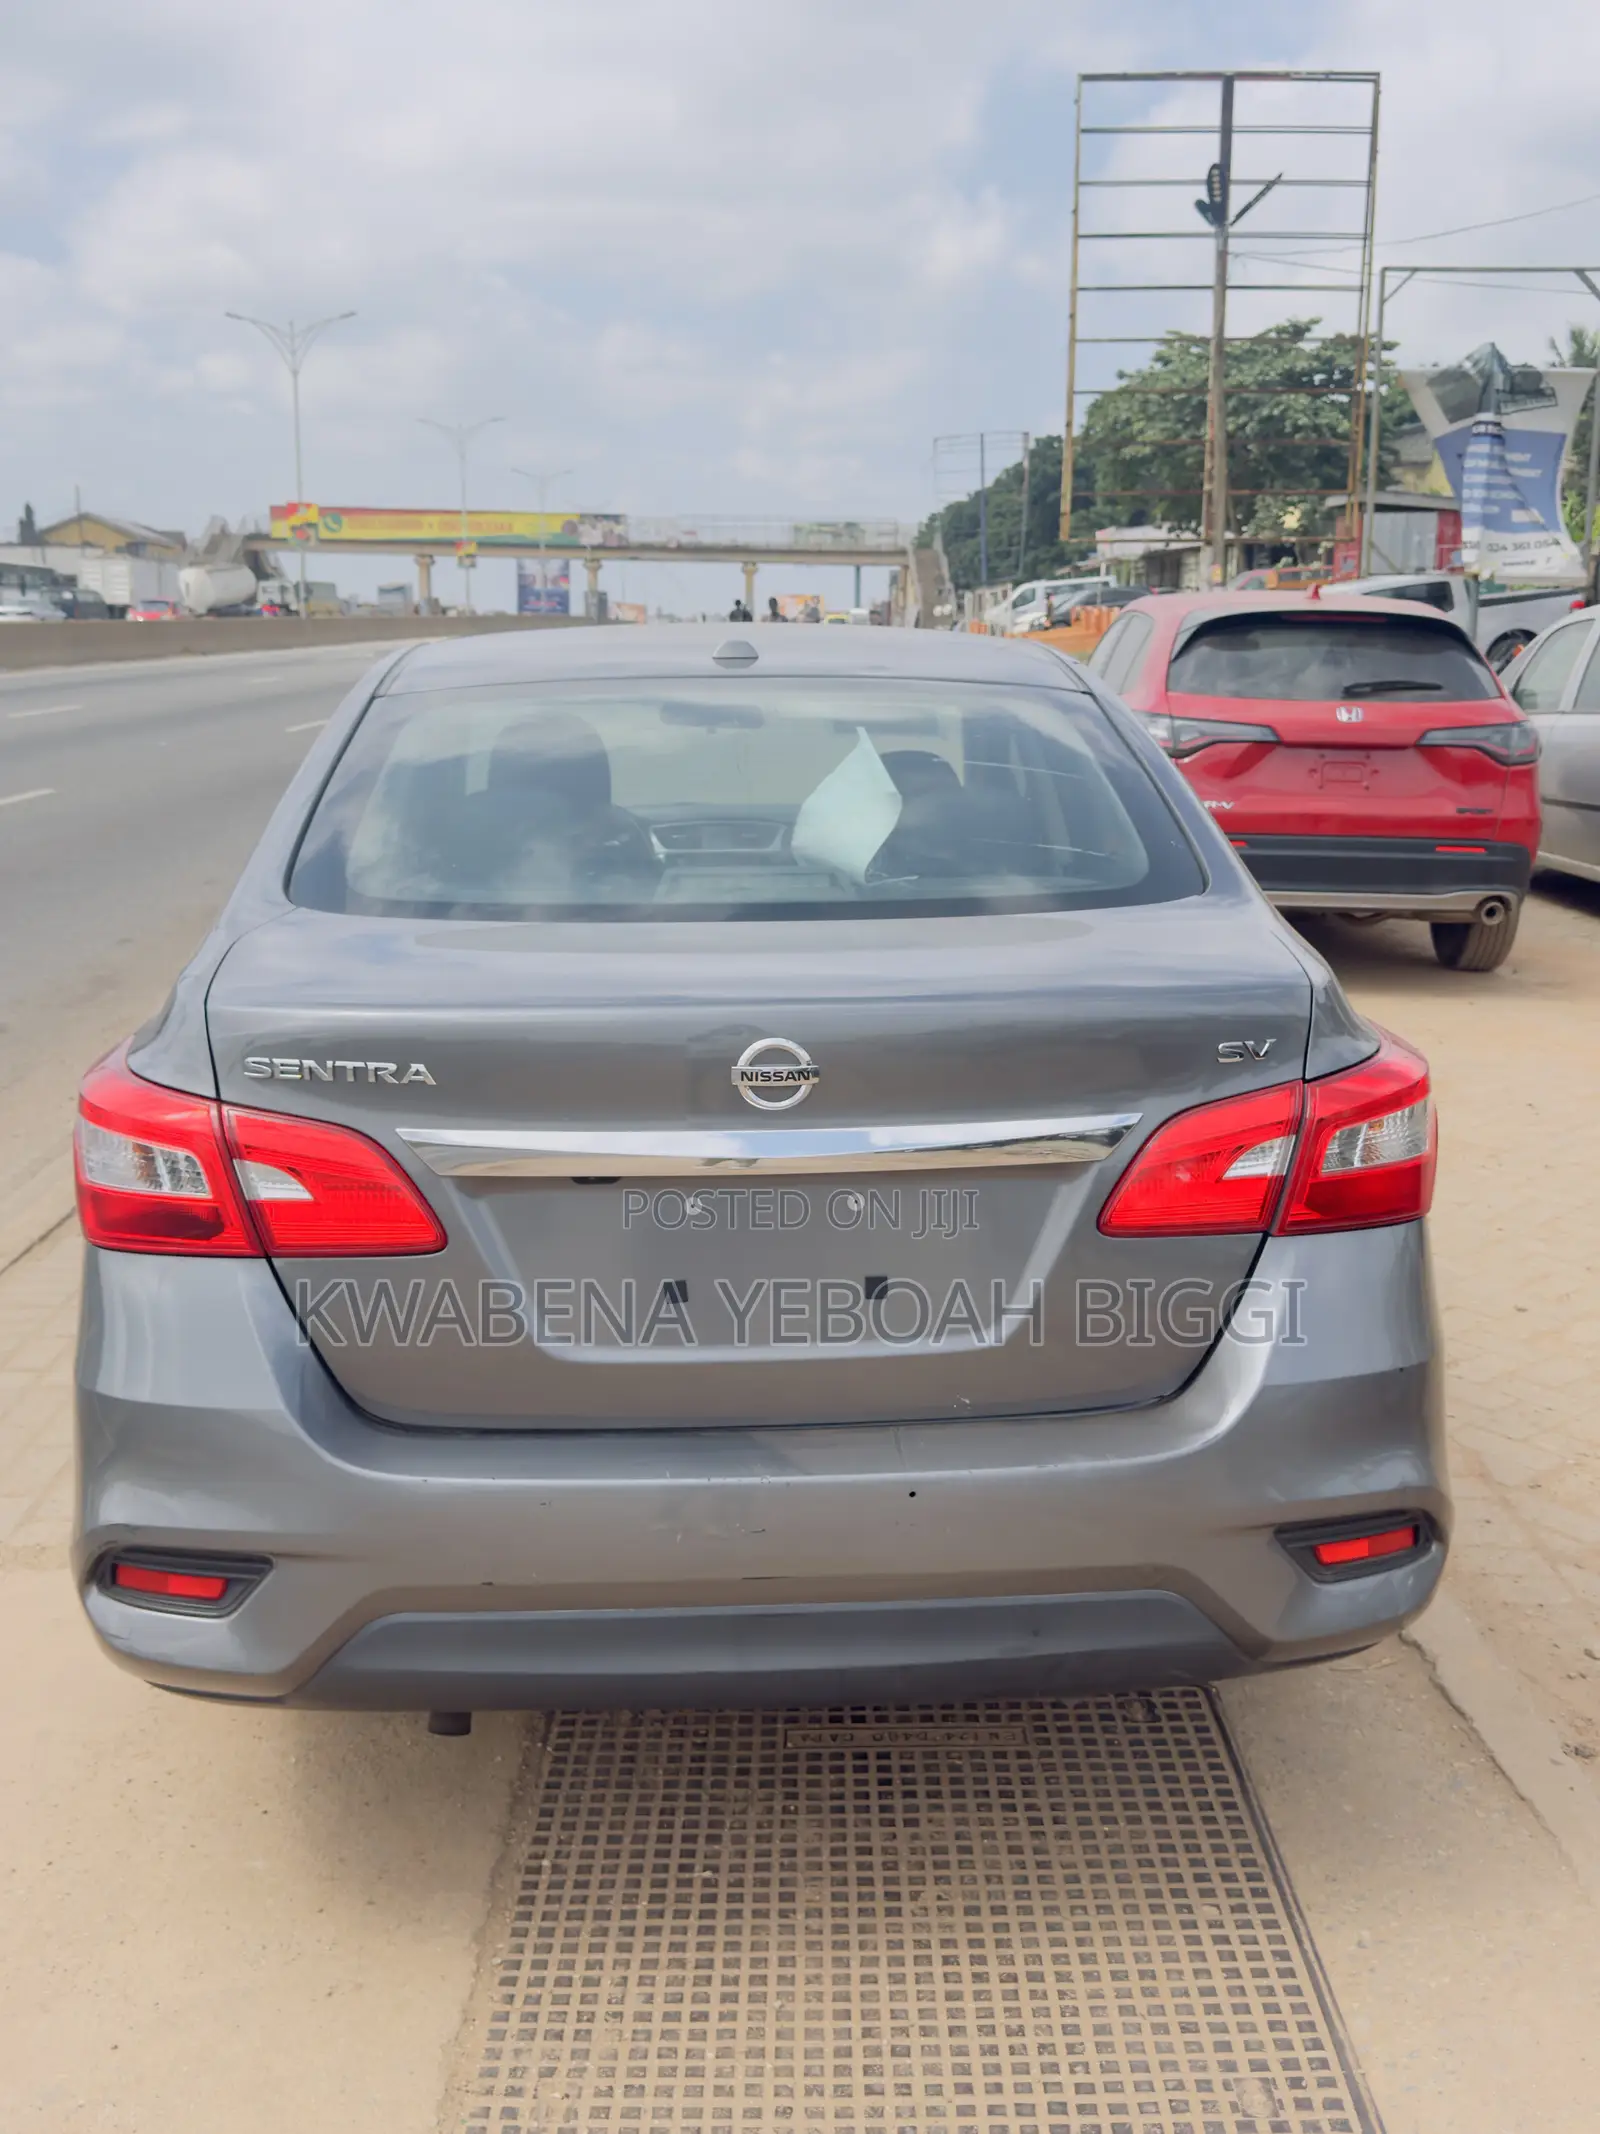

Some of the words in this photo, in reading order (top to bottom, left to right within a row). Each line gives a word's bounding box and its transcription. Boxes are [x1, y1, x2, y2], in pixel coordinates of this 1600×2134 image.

[1217, 1039, 1277, 1063] SV
[243, 1056, 437, 1086] SENTRA
[740, 1070, 811, 1083] NISSAN
